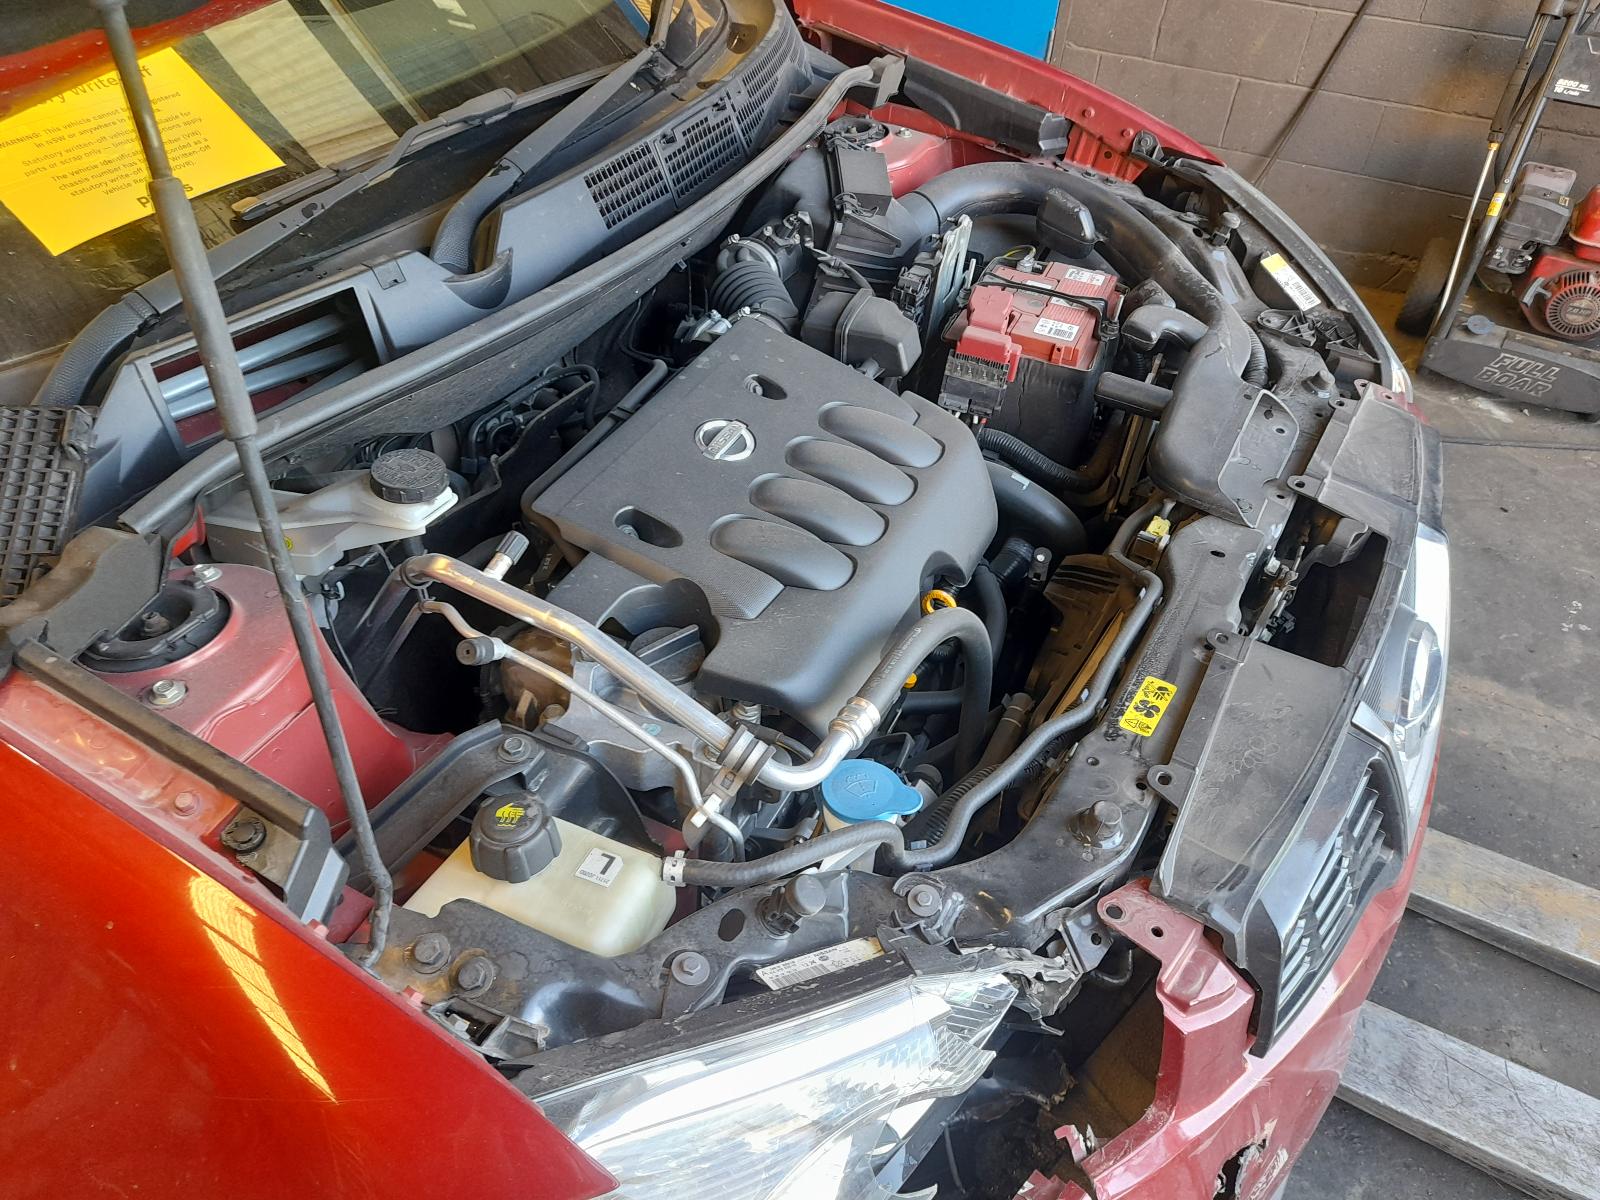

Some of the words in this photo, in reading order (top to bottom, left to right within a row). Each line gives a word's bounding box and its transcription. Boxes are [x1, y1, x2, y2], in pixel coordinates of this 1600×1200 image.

[63, 117, 91, 130] vehicle
[92, 109, 119, 121] cannot
[79, 120, 117, 136] anywhere
[22, 149, 64, 167] Statutory
[24, 165, 47, 177] parts
[51, 173, 69, 183] The
[58, 175, 90, 192] chassis
[91, 164, 122, 181] number
[70, 179, 109, 197] statutory
[1489, 353, 1561, 383] FULL
[1474, 366, 1553, 398] BOAR
[706, 423, 746, 458] NISSAN
